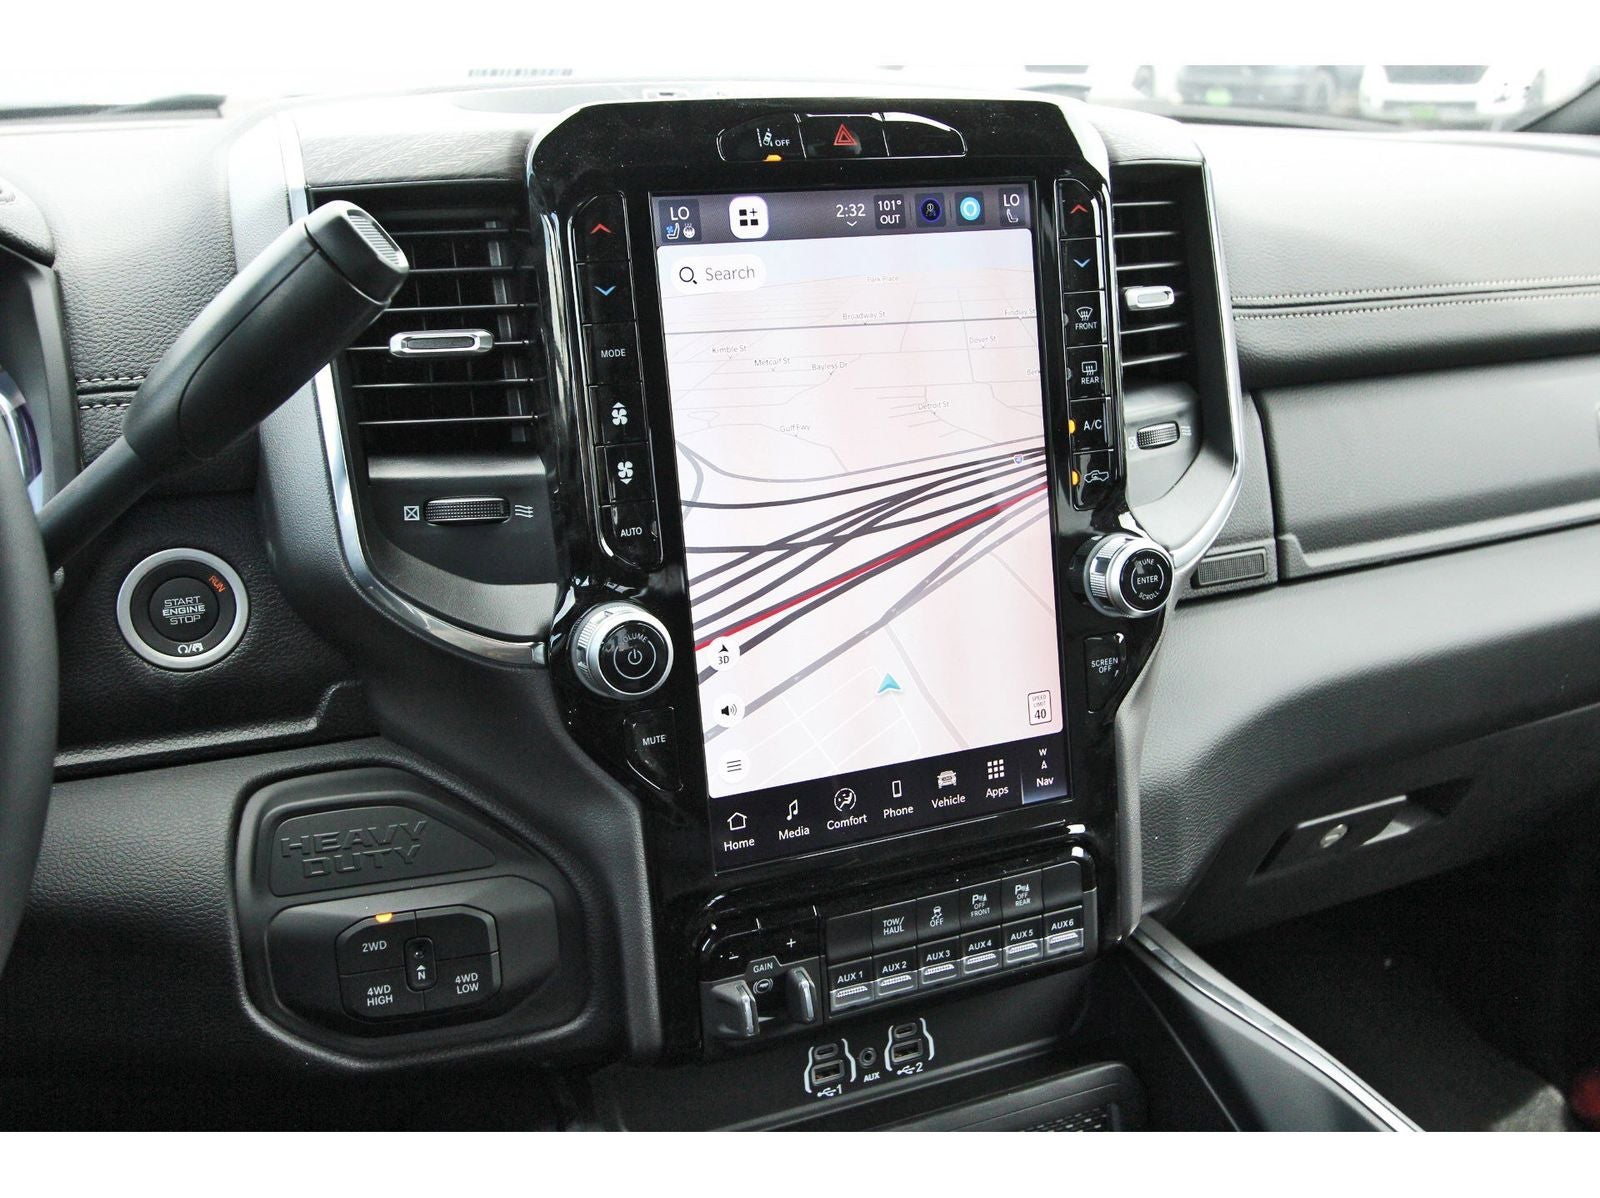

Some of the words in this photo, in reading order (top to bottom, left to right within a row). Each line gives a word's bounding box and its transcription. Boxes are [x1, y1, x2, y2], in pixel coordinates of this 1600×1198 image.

[775, 139, 790, 147] OFF
[878, 200, 902, 211] 101°
[1003, 194, 1019, 206] LO
[670, 206, 690, 220] LO
[836, 204, 866, 218] 2:32
[880, 214, 900, 224] OUT
[705, 266, 755, 281] Search
[1075, 321, 1097, 330] FRONT
[601, 349, 626, 358] MODE
[1081, 376, 1100, 385] REAR
[1083, 419, 1102, 431] A/C
[620, 527, 643, 537] AUTO
[208, 575, 226, 592] RUN
[1136, 574, 1158, 585] ENTER
[164, 595, 201, 607] START
[1138, 590, 1160, 600] SCROLL
[162, 604, 206, 616] ENGINE
[169, 614, 201, 626] STOP
[718, 655, 729, 665] 3D
[1091, 657, 1118, 668] SCREEN
[1098, 665, 1112, 674] OFF
[1034, 708, 1047, 720] 40
[642, 734, 666, 746] MUTE
[1038, 748, 1048, 756] W
[1036, 776, 1054, 787] Nav
[985, 785, 1009, 798] Apps
[931, 794, 966, 809] Vehicle
[883, 805, 914, 818] Phone
[827, 814, 868, 830] Comfort
[778, 825, 810, 840] Media
[281, 820, 427, 858] HEAVY
[723, 837, 755, 852] Home
[302, 844, 421, 878] DUTY
[1016, 892, 1028, 900] OFF
[973, 902, 985, 910] OFF
[1015, 898, 1031, 907] REAR
[970, 907, 990, 918] FRONT
[882, 914, 906, 928] TOW/
[929, 918, 944, 927] OFF
[1051, 920, 1068, 930] AUX
[1069, 918, 1074, 926] 6
[883, 924, 905, 936] HAUL
[1010, 931, 1027, 941] AUX
[1028, 929, 1034, 937] 5
[362, 940, 387, 953] 2WD
[968, 941, 985, 951] AUX
[986, 939, 992, 947] 4
[926, 951, 944, 962] AUX
[945, 950, 950, 958] 3
[753, 962, 774, 974] GAIN
[882, 962, 900, 974] AUX
[901, 961, 907, 969] 2
[417, 971, 426, 981] N
[455, 972, 478, 984] 4WD
[837, 972, 856, 984] AUX
[858, 970, 863, 979] 1
[367, 984, 392, 996] 4WD
[456, 982, 480, 995] LOW
[366, 994, 394, 1007] HIGH
[915, 1061, 924, 1073] 2
[863, 1071, 881, 1083] AUX
